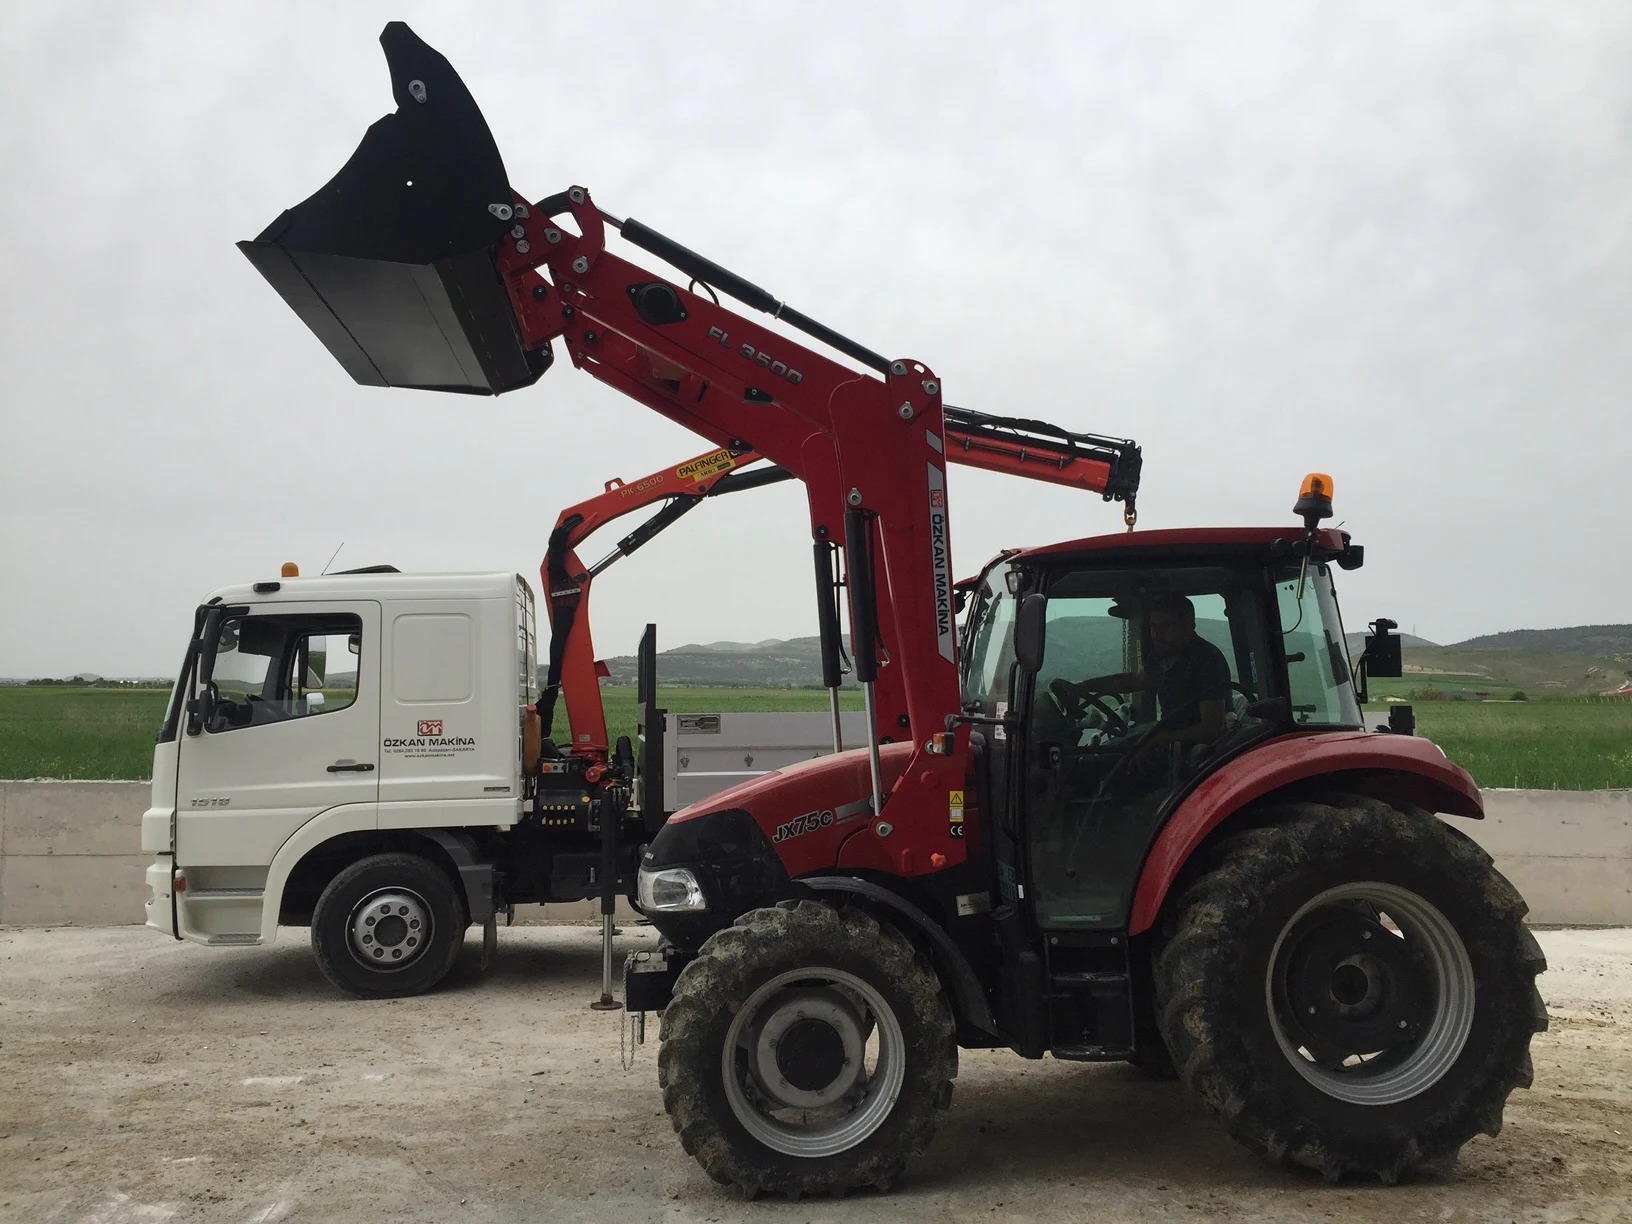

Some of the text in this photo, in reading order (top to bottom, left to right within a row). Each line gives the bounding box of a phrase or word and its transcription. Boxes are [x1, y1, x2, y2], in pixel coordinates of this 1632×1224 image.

[707, 326, 803, 386] FL 3500
[679, 450, 729, 477] PALFINGER
[620, 488, 635, 498] PK
[636, 475, 664, 491] 6500
[932, 514, 950, 636] ÖZKAN MAKİNA
[383, 736, 475, 747] ÖZKAN MAKİNA
[191, 797, 231, 807] 1518
[773, 810, 833, 842] JX75C
